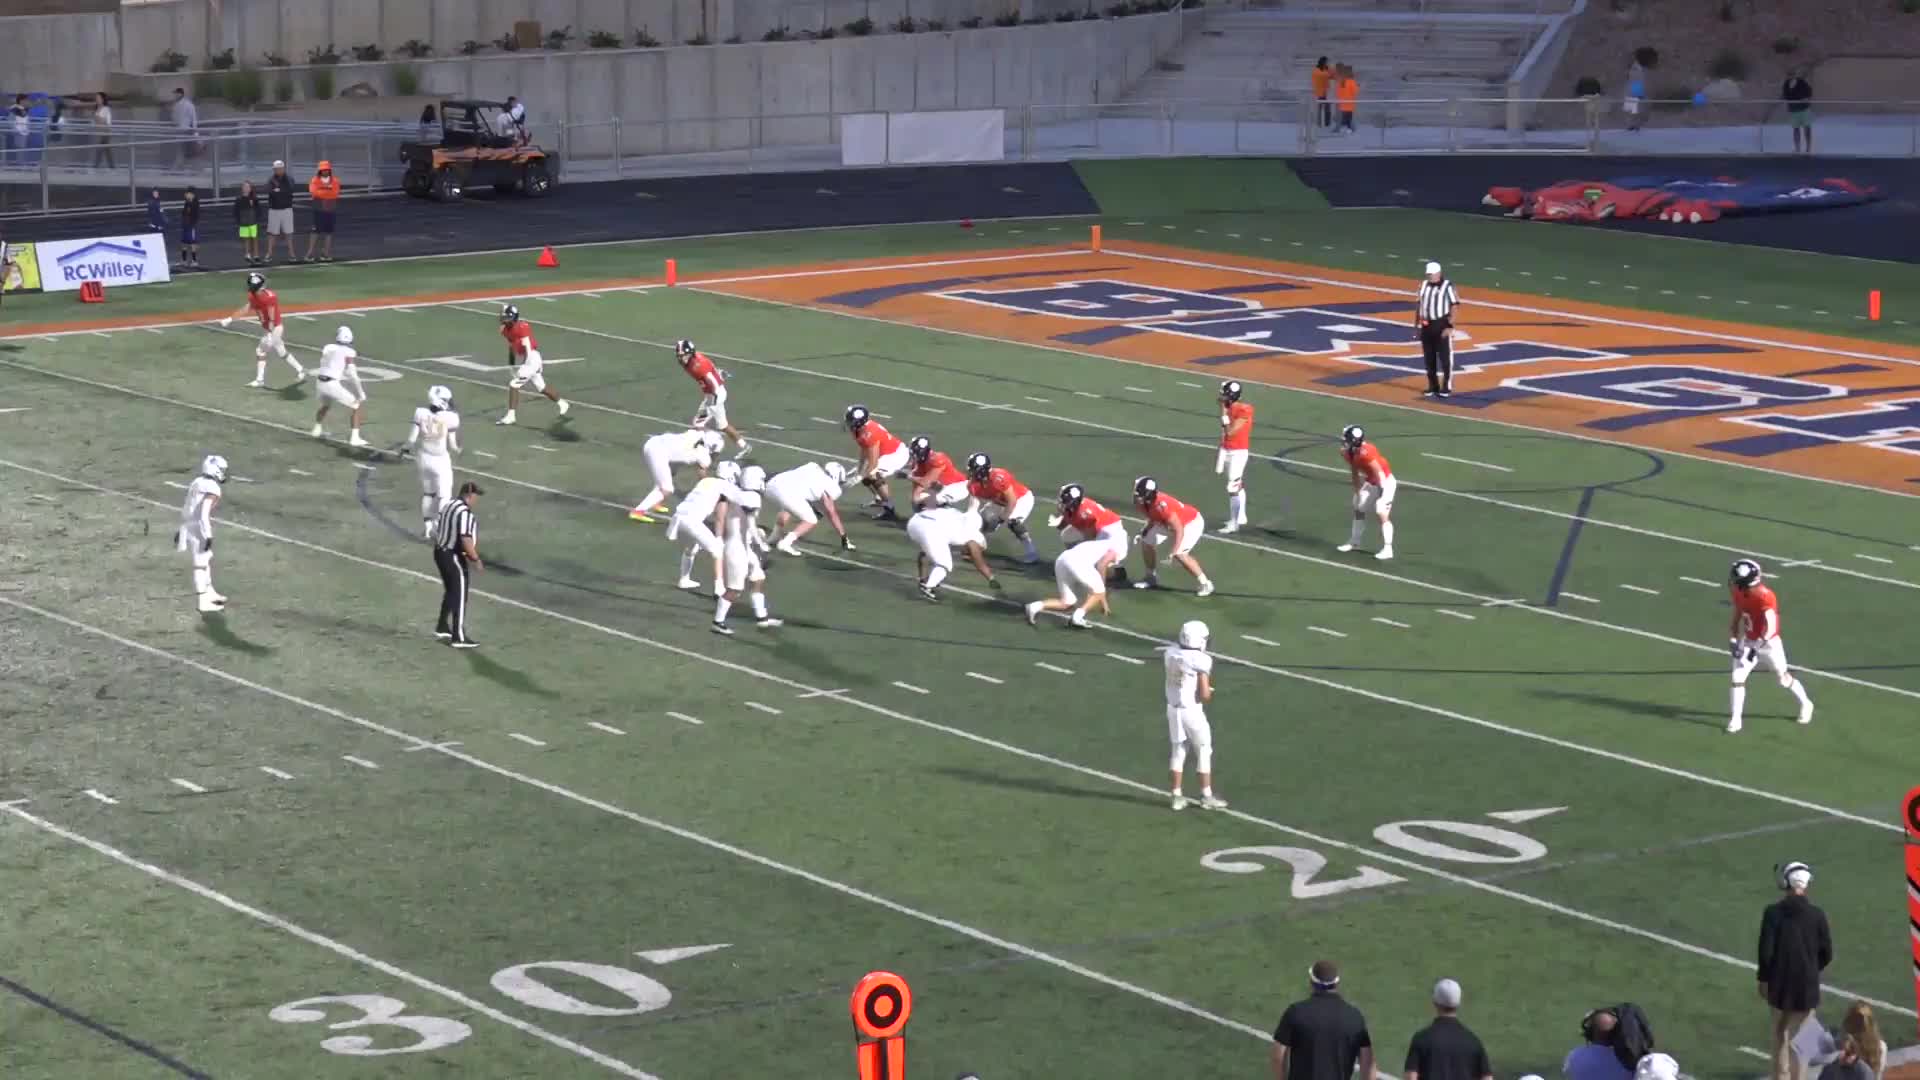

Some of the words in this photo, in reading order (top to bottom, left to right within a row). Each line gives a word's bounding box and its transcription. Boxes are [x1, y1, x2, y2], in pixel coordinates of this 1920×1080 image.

[85, 281, 102, 298] 10
[1200, 820, 1548, 899] 20
[268, 960, 672, 1056] 30
